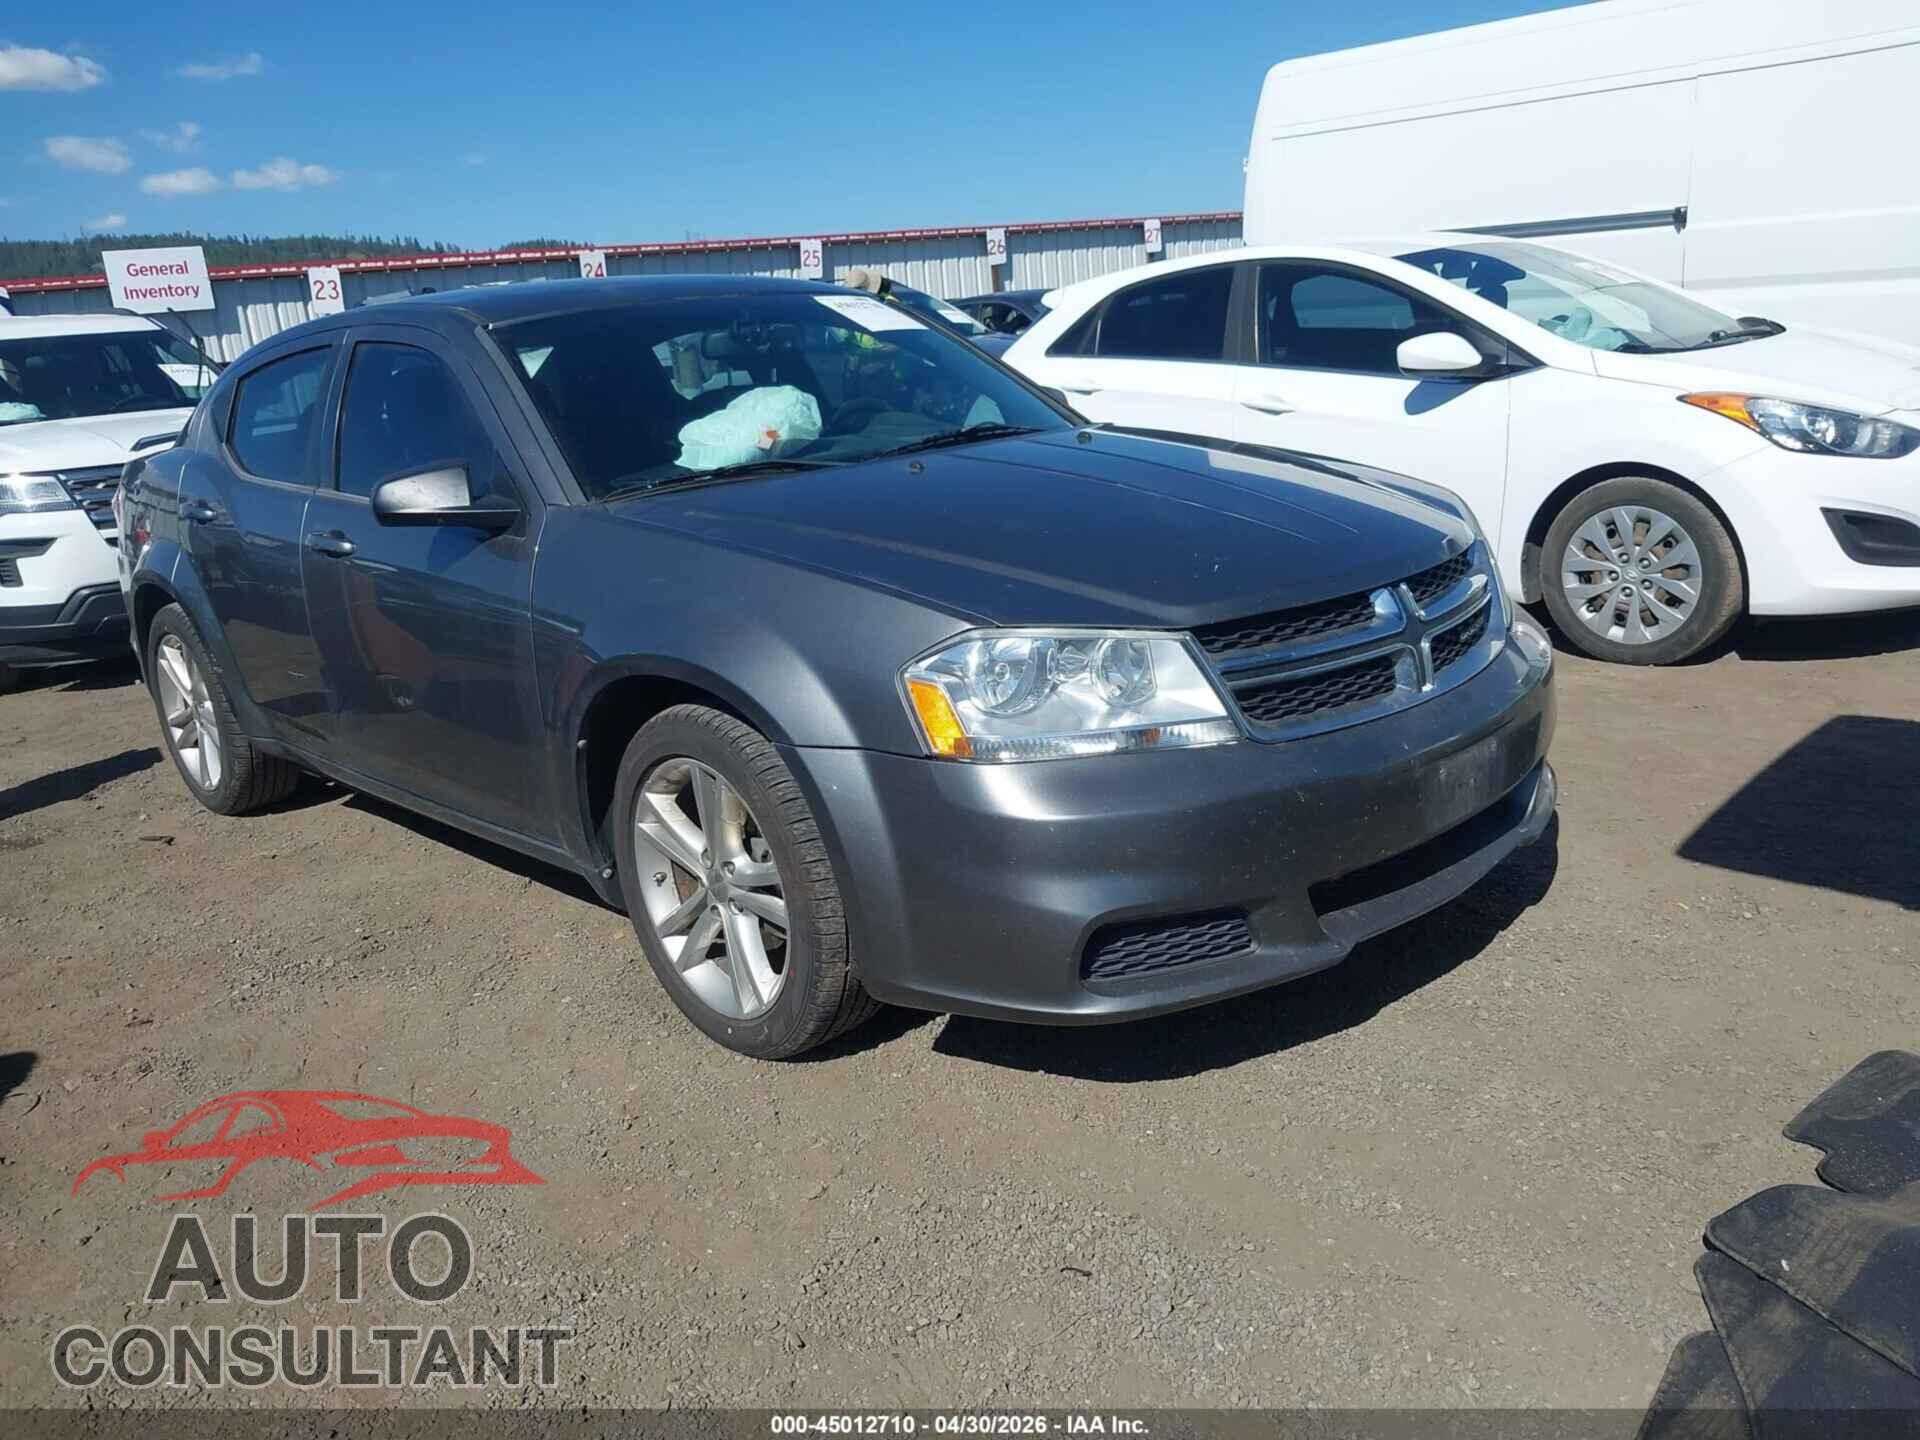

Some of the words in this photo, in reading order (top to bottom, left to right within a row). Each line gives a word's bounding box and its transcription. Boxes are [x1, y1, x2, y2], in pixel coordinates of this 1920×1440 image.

[1145, 228, 1160, 244] 27
[988, 239, 1005, 256] 26
[802, 249, 821, 268] 25
[126, 260, 189, 278] General
[583, 262, 605, 278] 24
[123, 283, 200, 301] Inventory
[312, 279, 341, 301] 23
